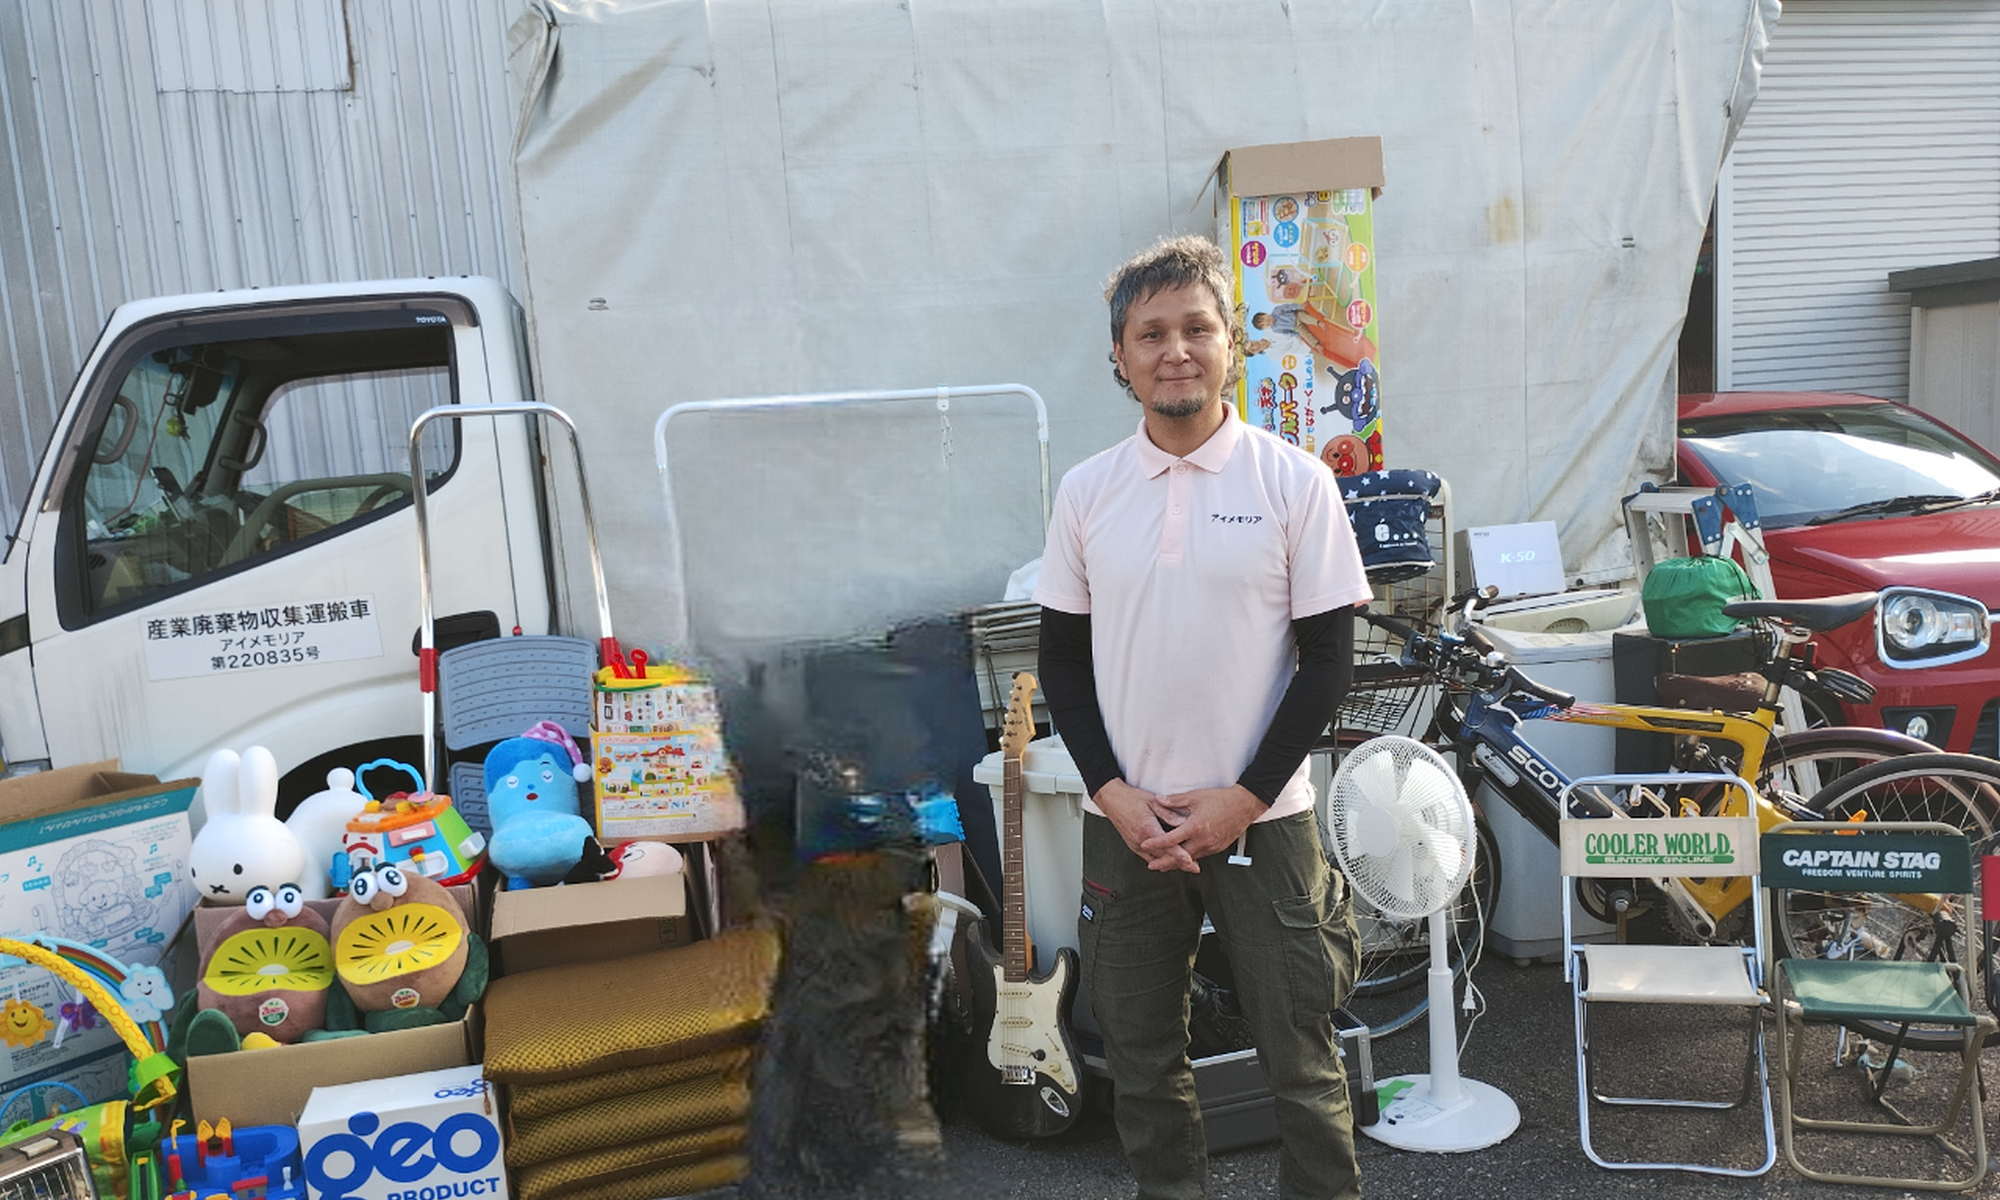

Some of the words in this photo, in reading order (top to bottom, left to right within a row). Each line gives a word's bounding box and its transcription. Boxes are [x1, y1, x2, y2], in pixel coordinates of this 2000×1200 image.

[1211, 513, 1263, 525] アイメモリア
[147, 598, 372, 641] 産業廃棄物収集運搬車
[219, 630, 306, 652] アイメモリア
[210, 645, 321, 671] 第220835号
[1584, 832, 1659, 855] COOLER
[1782, 849, 1880, 868] CAPTAIN
[1882, 851, 1941, 870] STAG
[1802, 868, 1843, 878] FREEDOM
[1845, 869, 1886, 879] VENTURE
[1888, 870, 1923, 879] SPIRITS
[304, 1111, 500, 1200] geo
